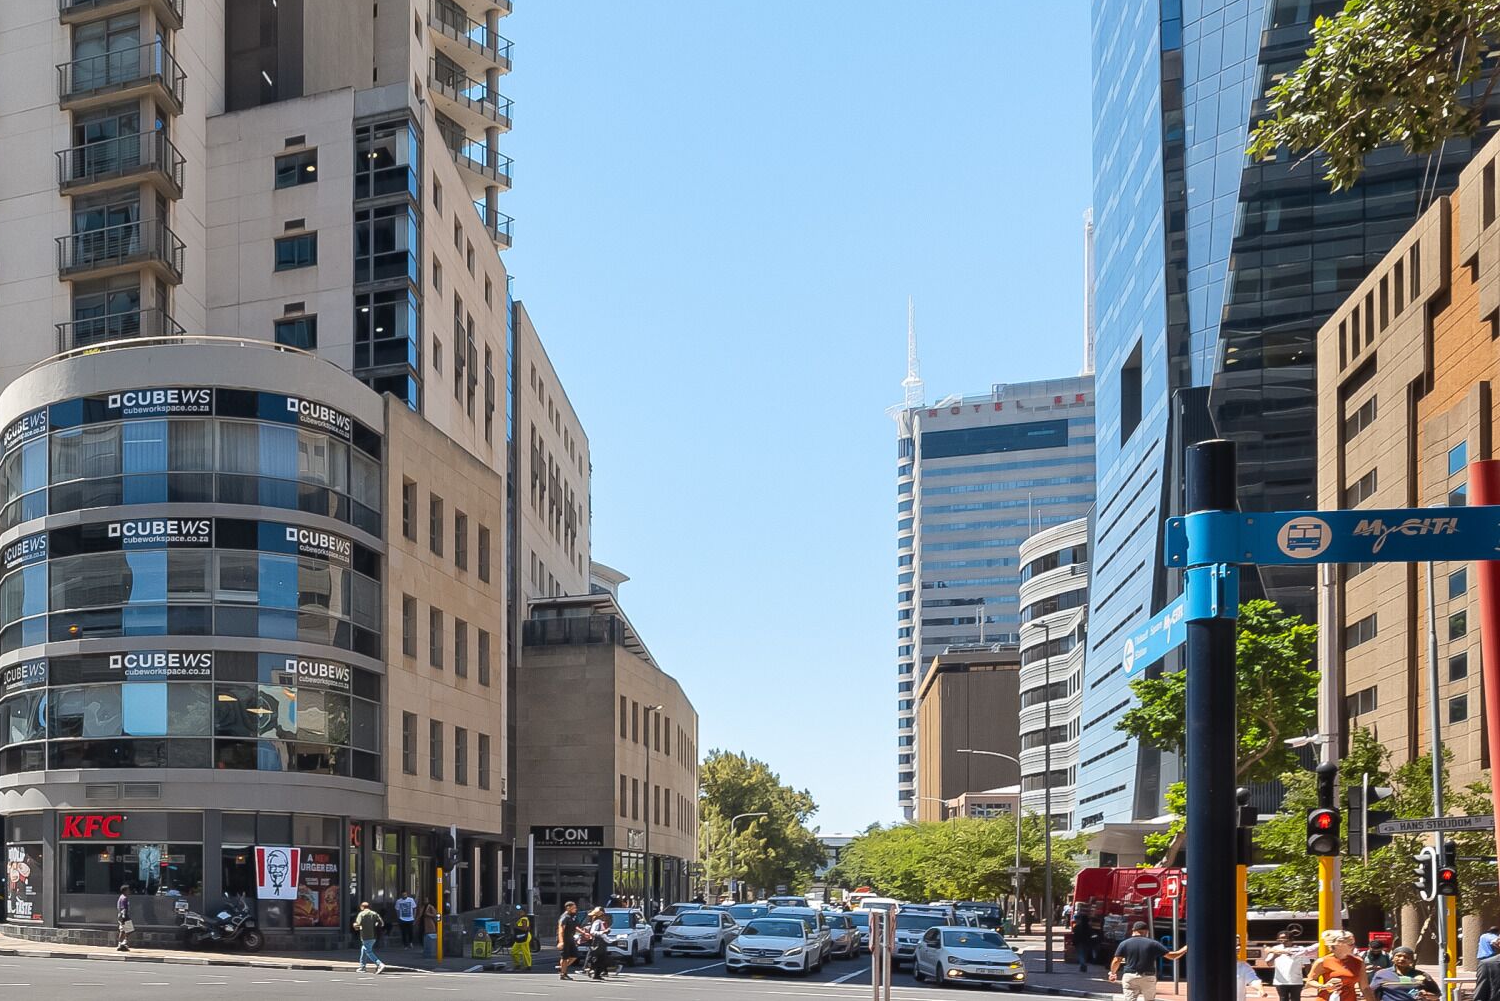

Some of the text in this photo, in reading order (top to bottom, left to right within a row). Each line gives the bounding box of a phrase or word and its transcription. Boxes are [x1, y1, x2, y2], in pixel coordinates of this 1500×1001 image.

[122, 389, 211, 406] CUBEWS
[123, 405, 210, 415] cubeworkspace.co.za
[299, 401, 351, 431] CUBEWS
[928, 400, 1025, 418] HOTEL
[122, 520, 211, 536] CUBEWS
[123, 535, 210, 544] cubeworkspace.co.za
[299, 530, 351, 555] CUBEWS
[6, 535, 47, 561] CUBEWS
[124, 653, 212, 668] CUBEWS
[6, 662, 46, 683] CUBEWS
[124, 668, 211, 676] cubeworkspace.co.za
[298, 661, 350, 682] CUBEWS
[61, 815, 122, 838] KFC
[545, 827, 588, 842] ICON
[1400, 822, 1424, 831] HANS
[350, 824, 362, 847] FC
[307, 853, 314, 862] A
[300, 863, 326, 872] URGER
